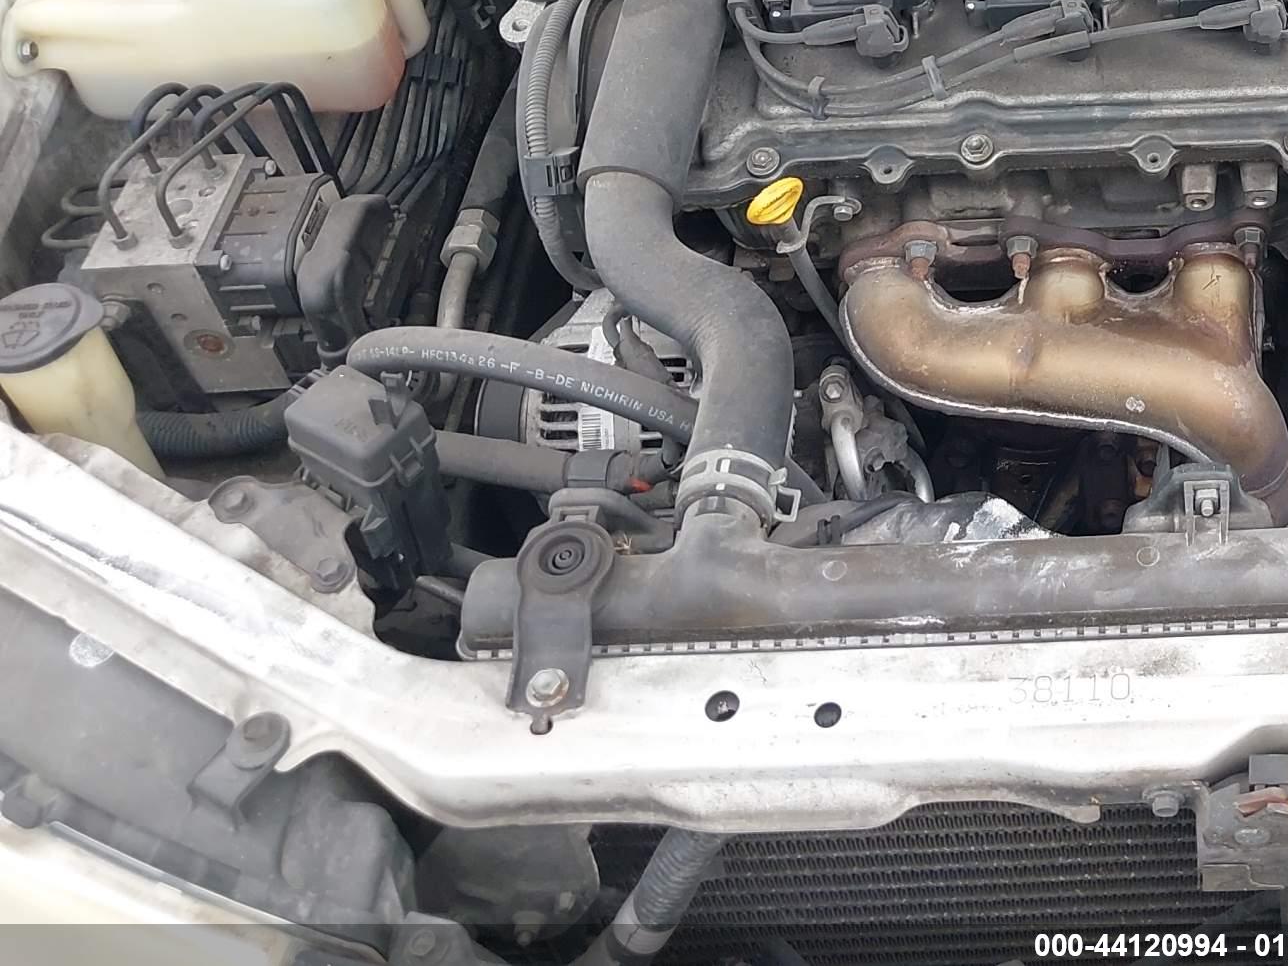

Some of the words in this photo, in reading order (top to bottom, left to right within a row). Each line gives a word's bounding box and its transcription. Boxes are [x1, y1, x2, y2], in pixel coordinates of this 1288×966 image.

[478, 355, 496, 368] 26
[580, 382, 644, 411] NICHIRIN
[648, 407, 674, 425] USA
[1008, 673, 1130, 704] 38110
